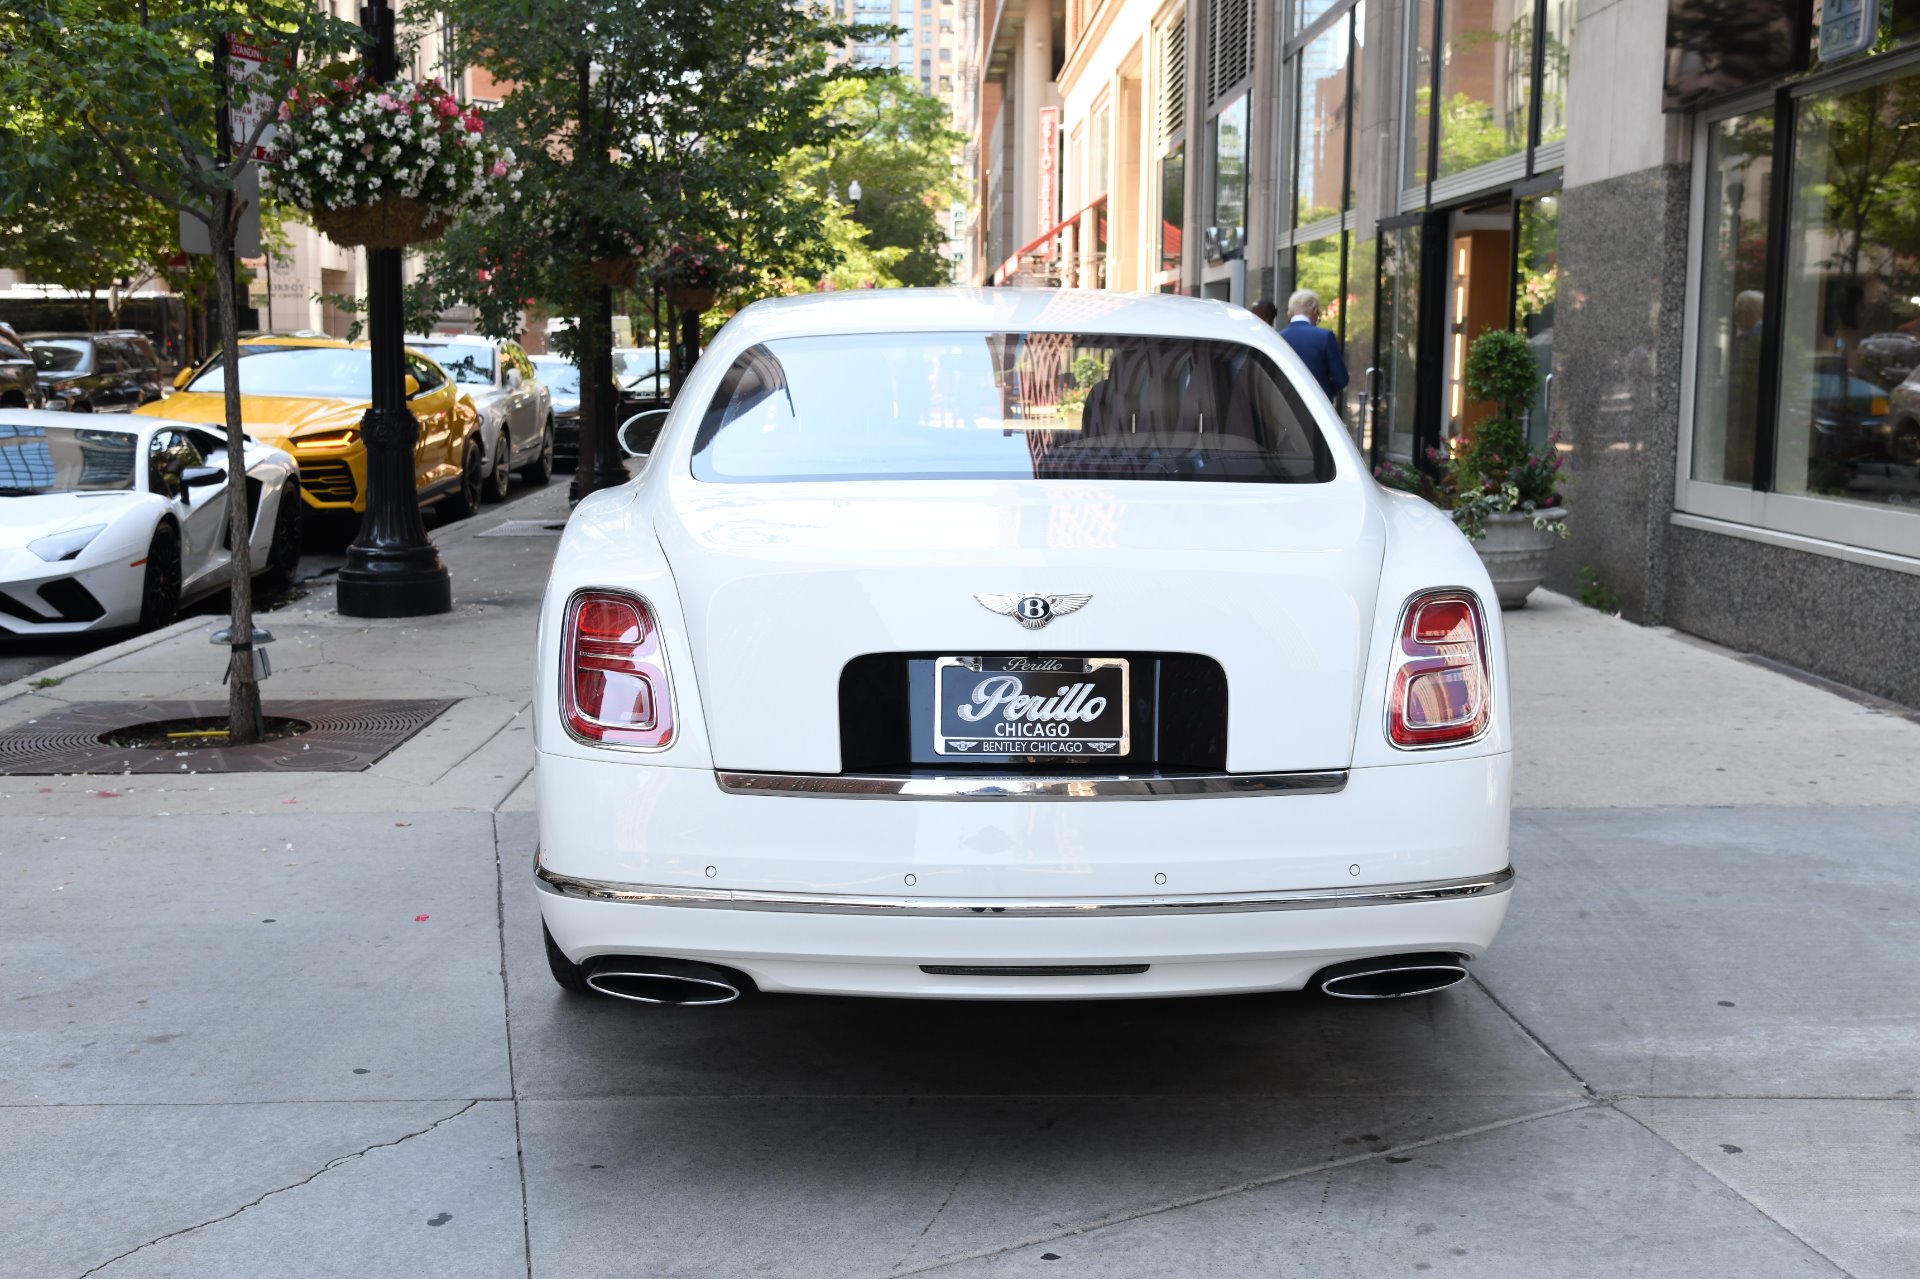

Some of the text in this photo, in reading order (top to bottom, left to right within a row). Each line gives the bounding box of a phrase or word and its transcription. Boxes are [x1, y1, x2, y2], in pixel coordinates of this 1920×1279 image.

[231, 43, 265, 60] STANDIN
[1023, 598, 1045, 618] B
[1002, 657, 1063, 671] Perillo
[957, 675, 1107, 723] Perillo
[994, 722, 1070, 737] CHICAGO
[982, 741, 1083, 753] BENTLEY CHICAGO
